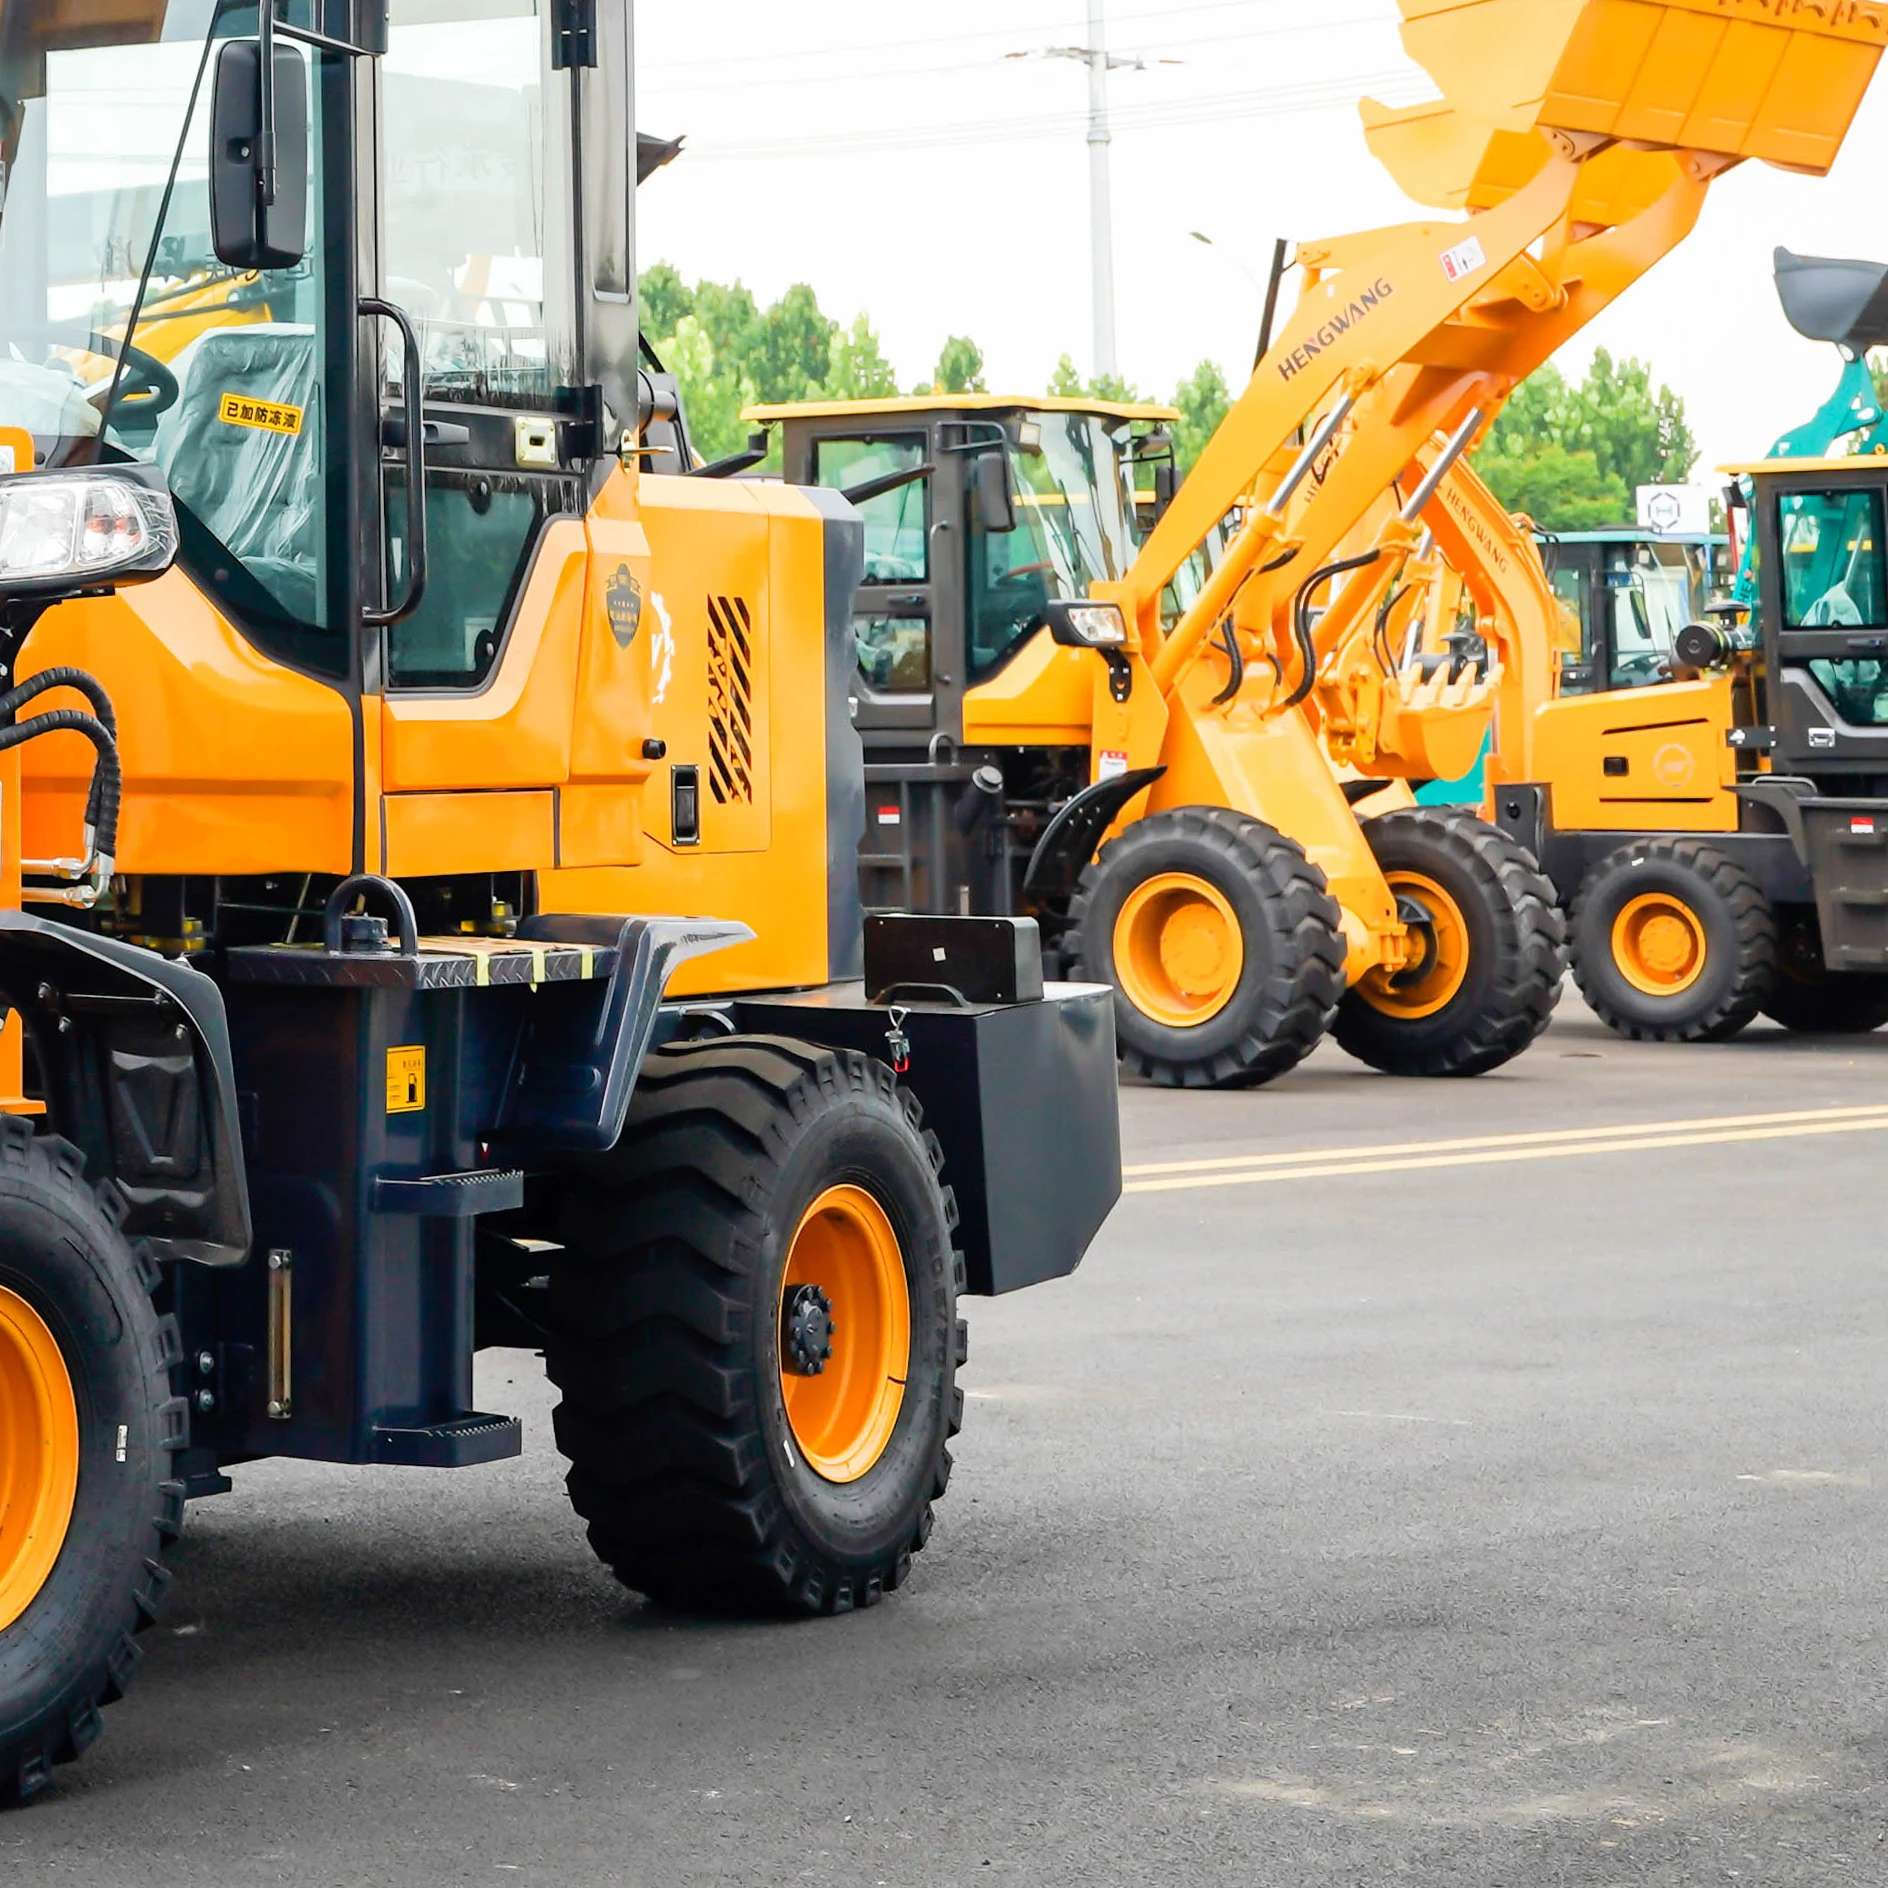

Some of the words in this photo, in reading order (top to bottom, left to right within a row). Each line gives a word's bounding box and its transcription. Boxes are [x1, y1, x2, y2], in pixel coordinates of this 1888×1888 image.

[1277, 276, 1393, 382] HENGWANG
[226, 401, 297, 429] 已加防冻液
[1446, 488, 1509, 574] HENGWANG
